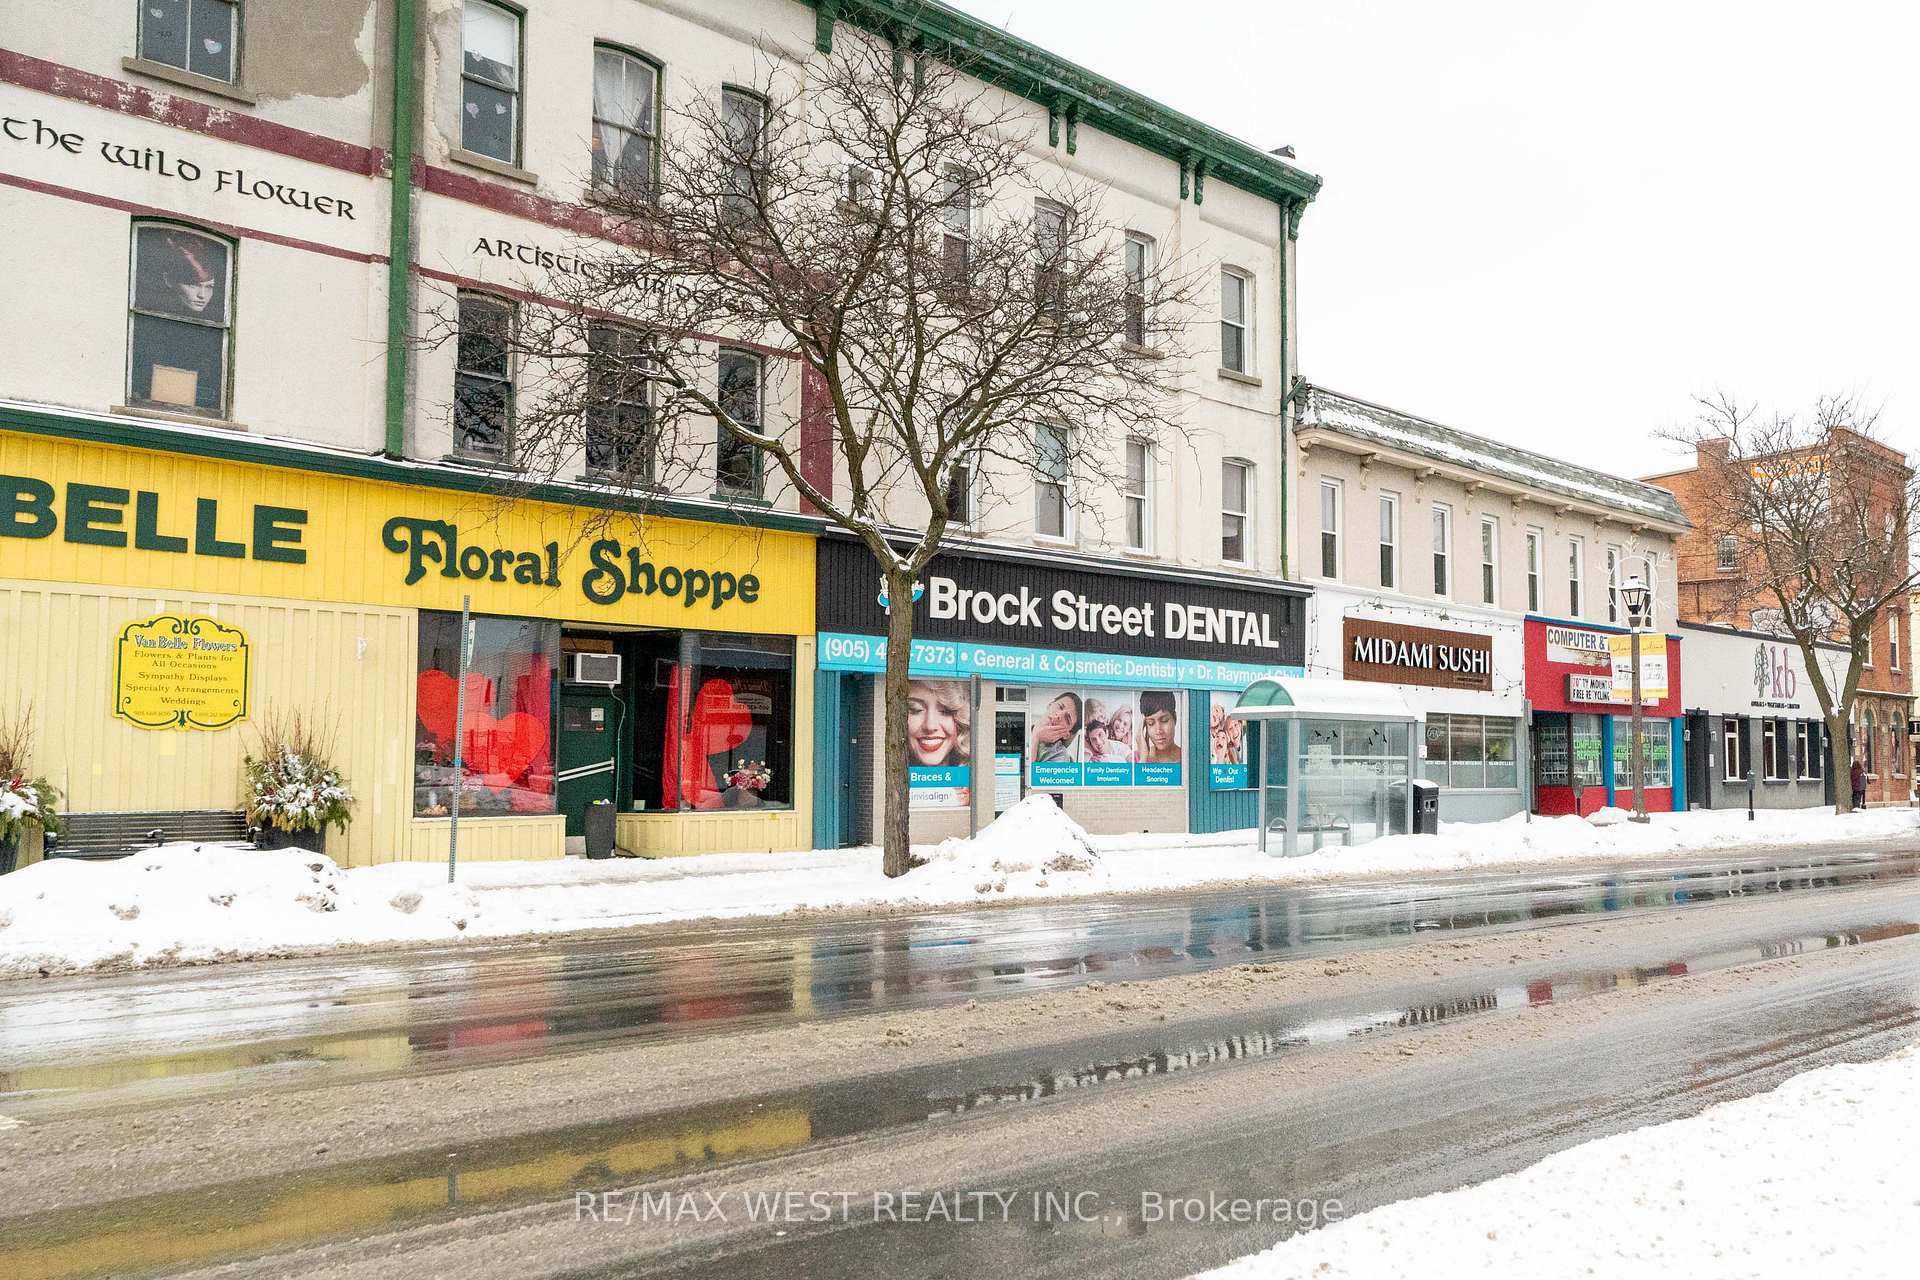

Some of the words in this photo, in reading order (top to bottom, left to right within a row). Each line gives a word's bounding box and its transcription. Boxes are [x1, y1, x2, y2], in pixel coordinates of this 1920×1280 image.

[0, 474, 308, 565] BELLE
[381, 515, 562, 588] Floral
[581, 538, 761, 610] Shoppe
[929, 576, 1043, 628] Brock
[1051, 589, 1155, 638] Street
[1164, 602, 1280, 649] DENTAL
[134, 634, 156, 649] Van
[158, 636, 188, 650] Belle
[193, 637, 238, 652] Flowers
[1548, 628, 1596, 650] COMPUTER
[134, 650, 172, 659] Flowers
[188, 652, 217, 661] Plants
[220, 654, 233, 662] for
[1354, 635, 1433, 669] MIDAMI
[1438, 645, 1490, 674] SUSHI
[151, 660, 166, 668] All
[169, 661, 217, 670] Occasions
[825, 637, 869, 663] (905)
[973, 649, 1035, 671] General
[1039, 655, 1050, 669] &
[1054, 654, 1122, 676] Cosmetic
[1125, 659, 1185, 682] Dentistry
[1197, 664, 1214, 680] Dr.
[1216, 665, 1271, 685] Raymond
[138, 671, 185, 681] Sympathy
[189, 673, 228, 682] Displays
[125, 683, 170, 694] Specialty
[174, 685, 239, 695] Arrangements
[160, 696, 206, 706] Weddings
[1035, 766, 1079, 776] Emergencies
[1087, 767, 1105, 776] Family
[1105, 767, 1130, 776] Dentistry
[1142, 766, 1173, 774] Headaches
[1212, 767, 1222, 775] We
[1228, 767, 1239, 775] Our
[910, 772, 943, 782] Braces
[944, 772, 952, 781] &
[1039, 777, 1075, 785] Welcomed
[1097, 775, 1120, 783] Implants
[1146, 775, 1169, 784] Snoring
[1215, 775, 1235, 783] Dentist
[911, 791, 949, 803] invisalign
